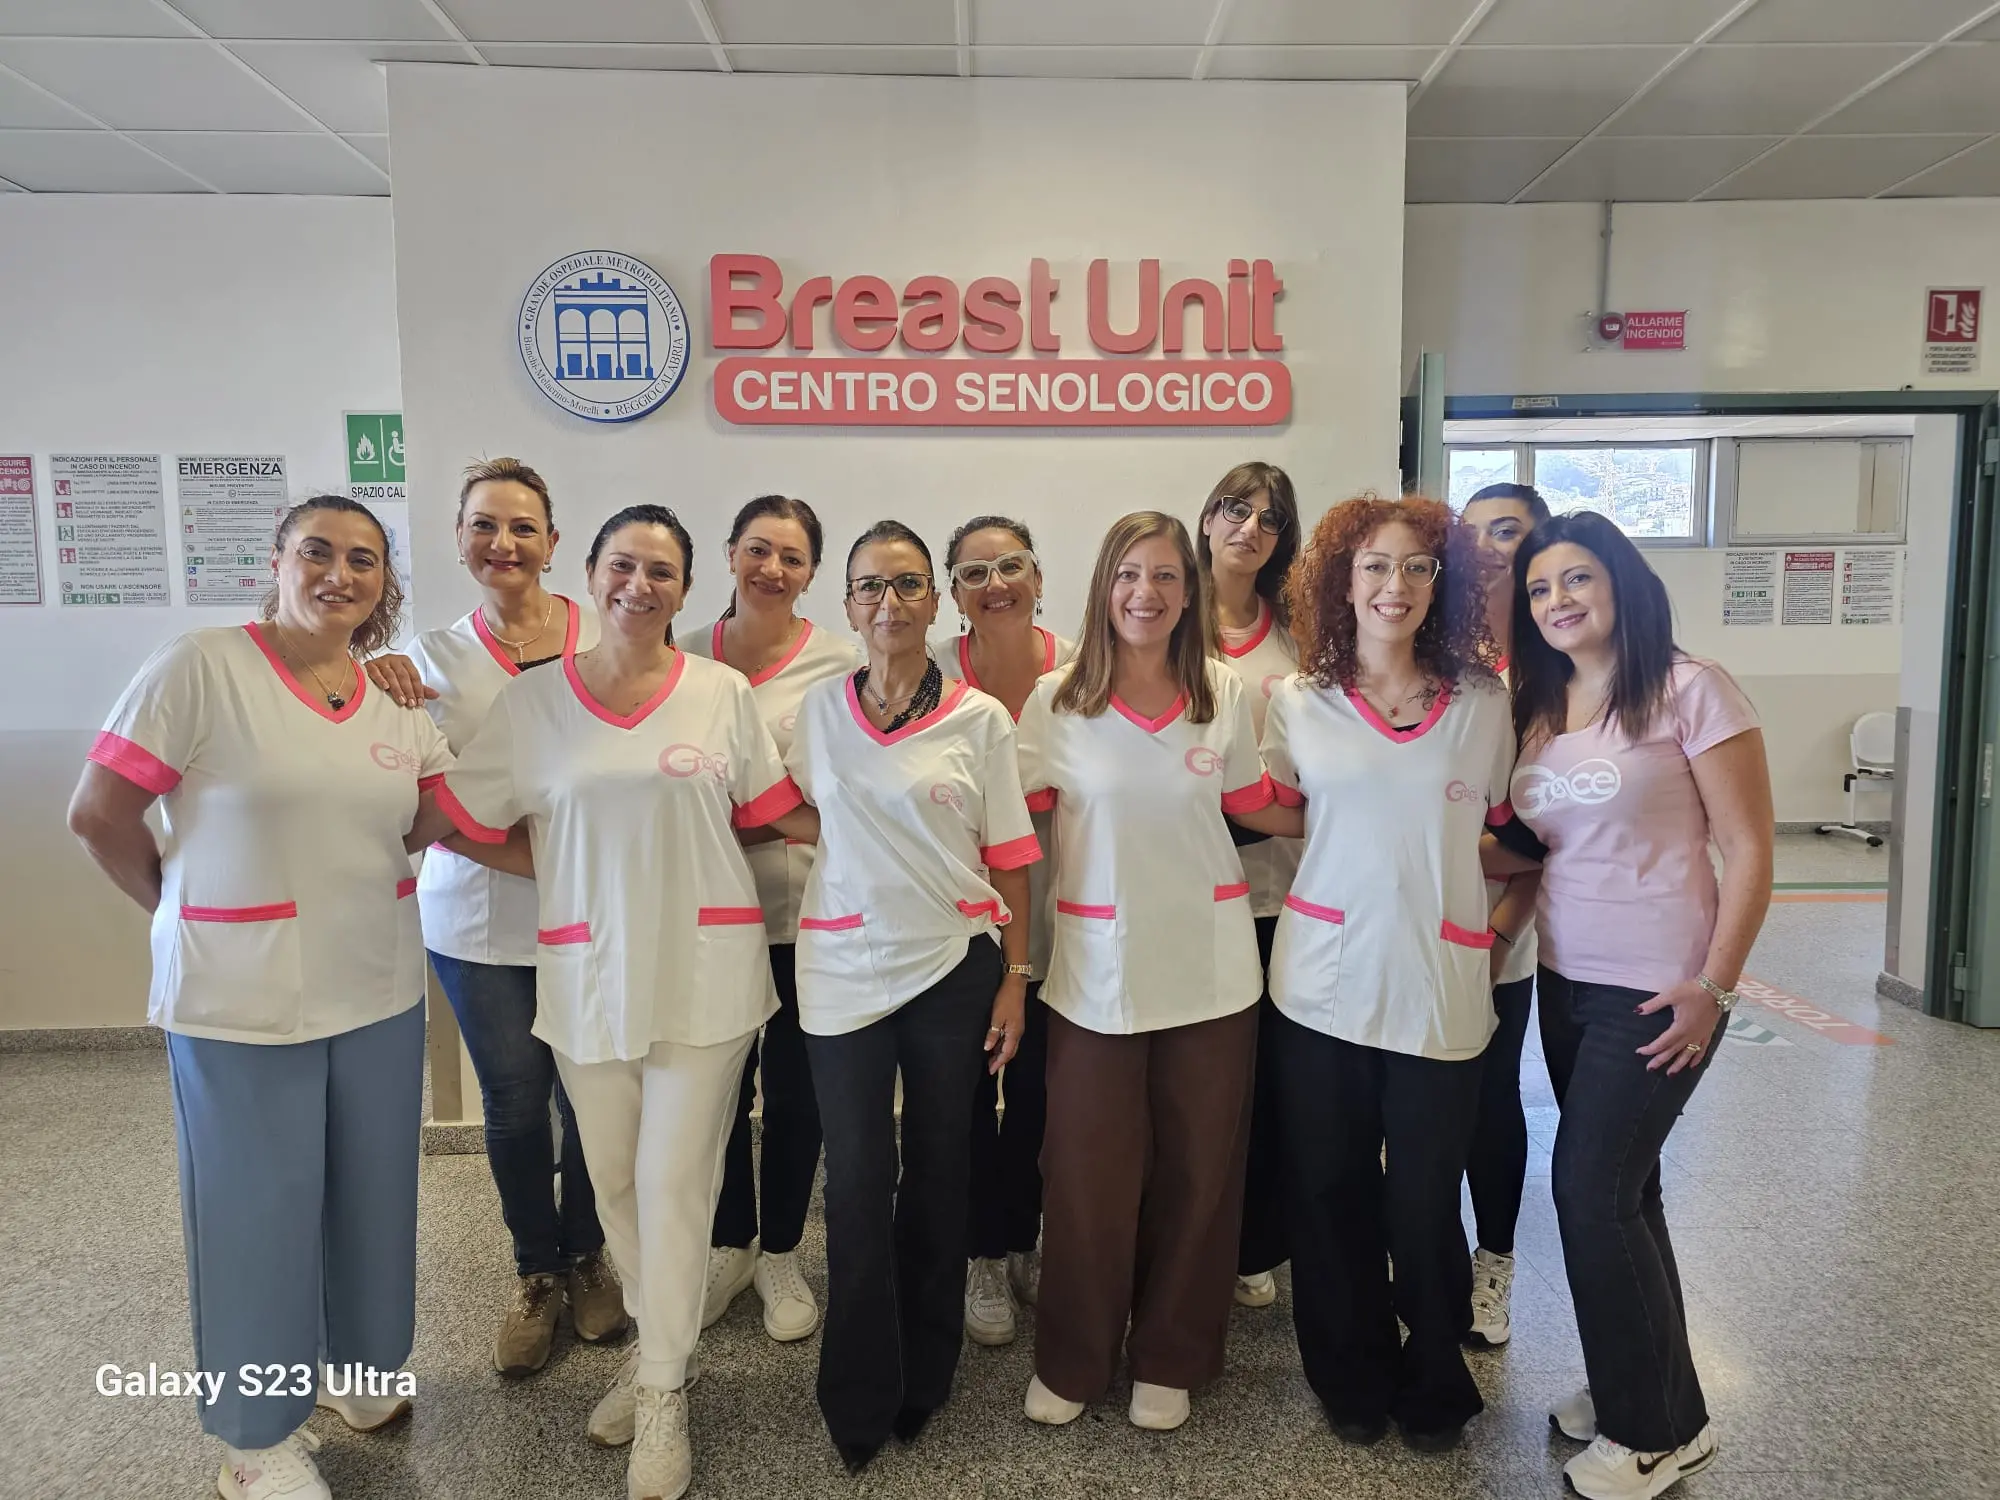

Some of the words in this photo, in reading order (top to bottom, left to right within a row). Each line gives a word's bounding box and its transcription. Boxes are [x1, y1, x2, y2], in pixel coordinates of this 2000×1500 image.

[524, 279, 550, 322] GRANDE
[550, 255, 604, 281] OSPEDALE
[606, 255, 680, 323] METROPOLITANO
[710, 253, 1061, 353] Breast
[1087, 257, 1284, 354] Unit
[1627, 316, 1683, 327] ALLARME
[1626, 328, 1683, 339] INCENDIO
[732, 370, 938, 411] CENTRO
[955, 371, 1273, 414] SENOLOGICO
[178, 463, 282, 475] EMERGENZA
[351, 486, 385, 499] SPAZIO
[387, 486, 406, 499] CAL
